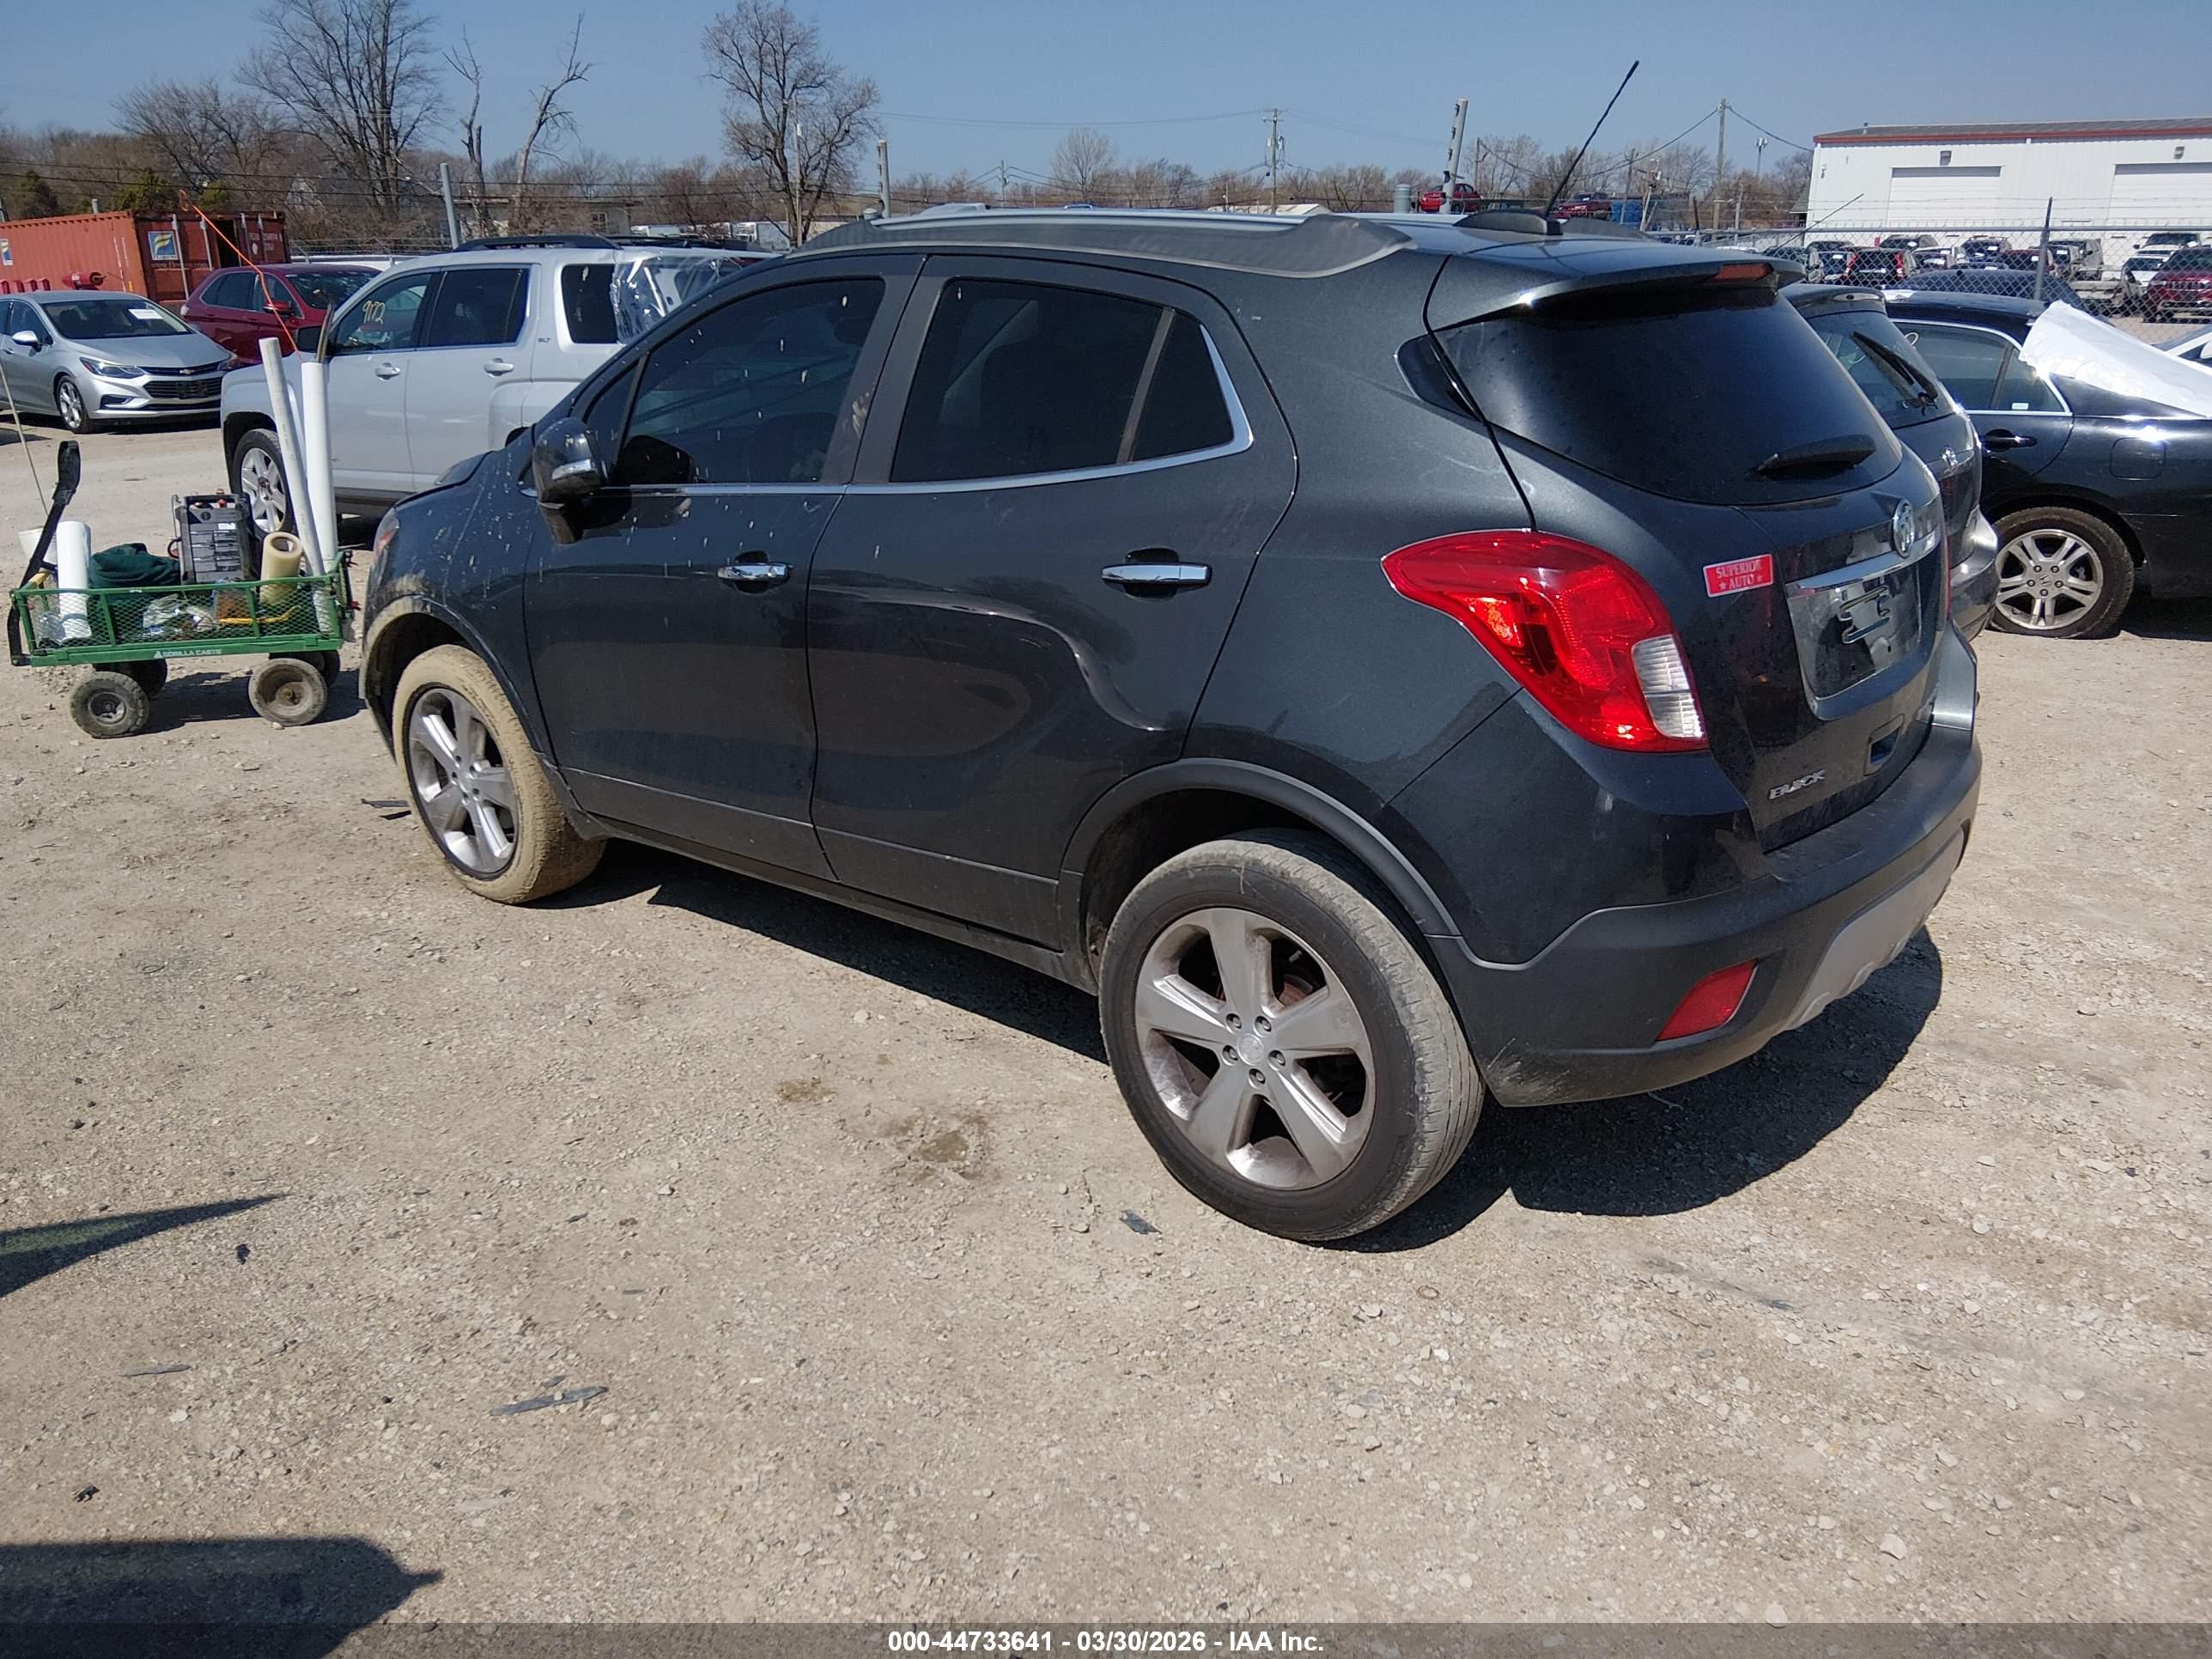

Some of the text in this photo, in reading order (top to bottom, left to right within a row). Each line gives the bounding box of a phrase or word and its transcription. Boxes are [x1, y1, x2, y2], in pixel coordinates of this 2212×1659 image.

[1716, 559, 1761, 579] SUPERIOR
[1729, 574, 1755, 589] AUTO
[1768, 769, 1826, 800] BUICK
